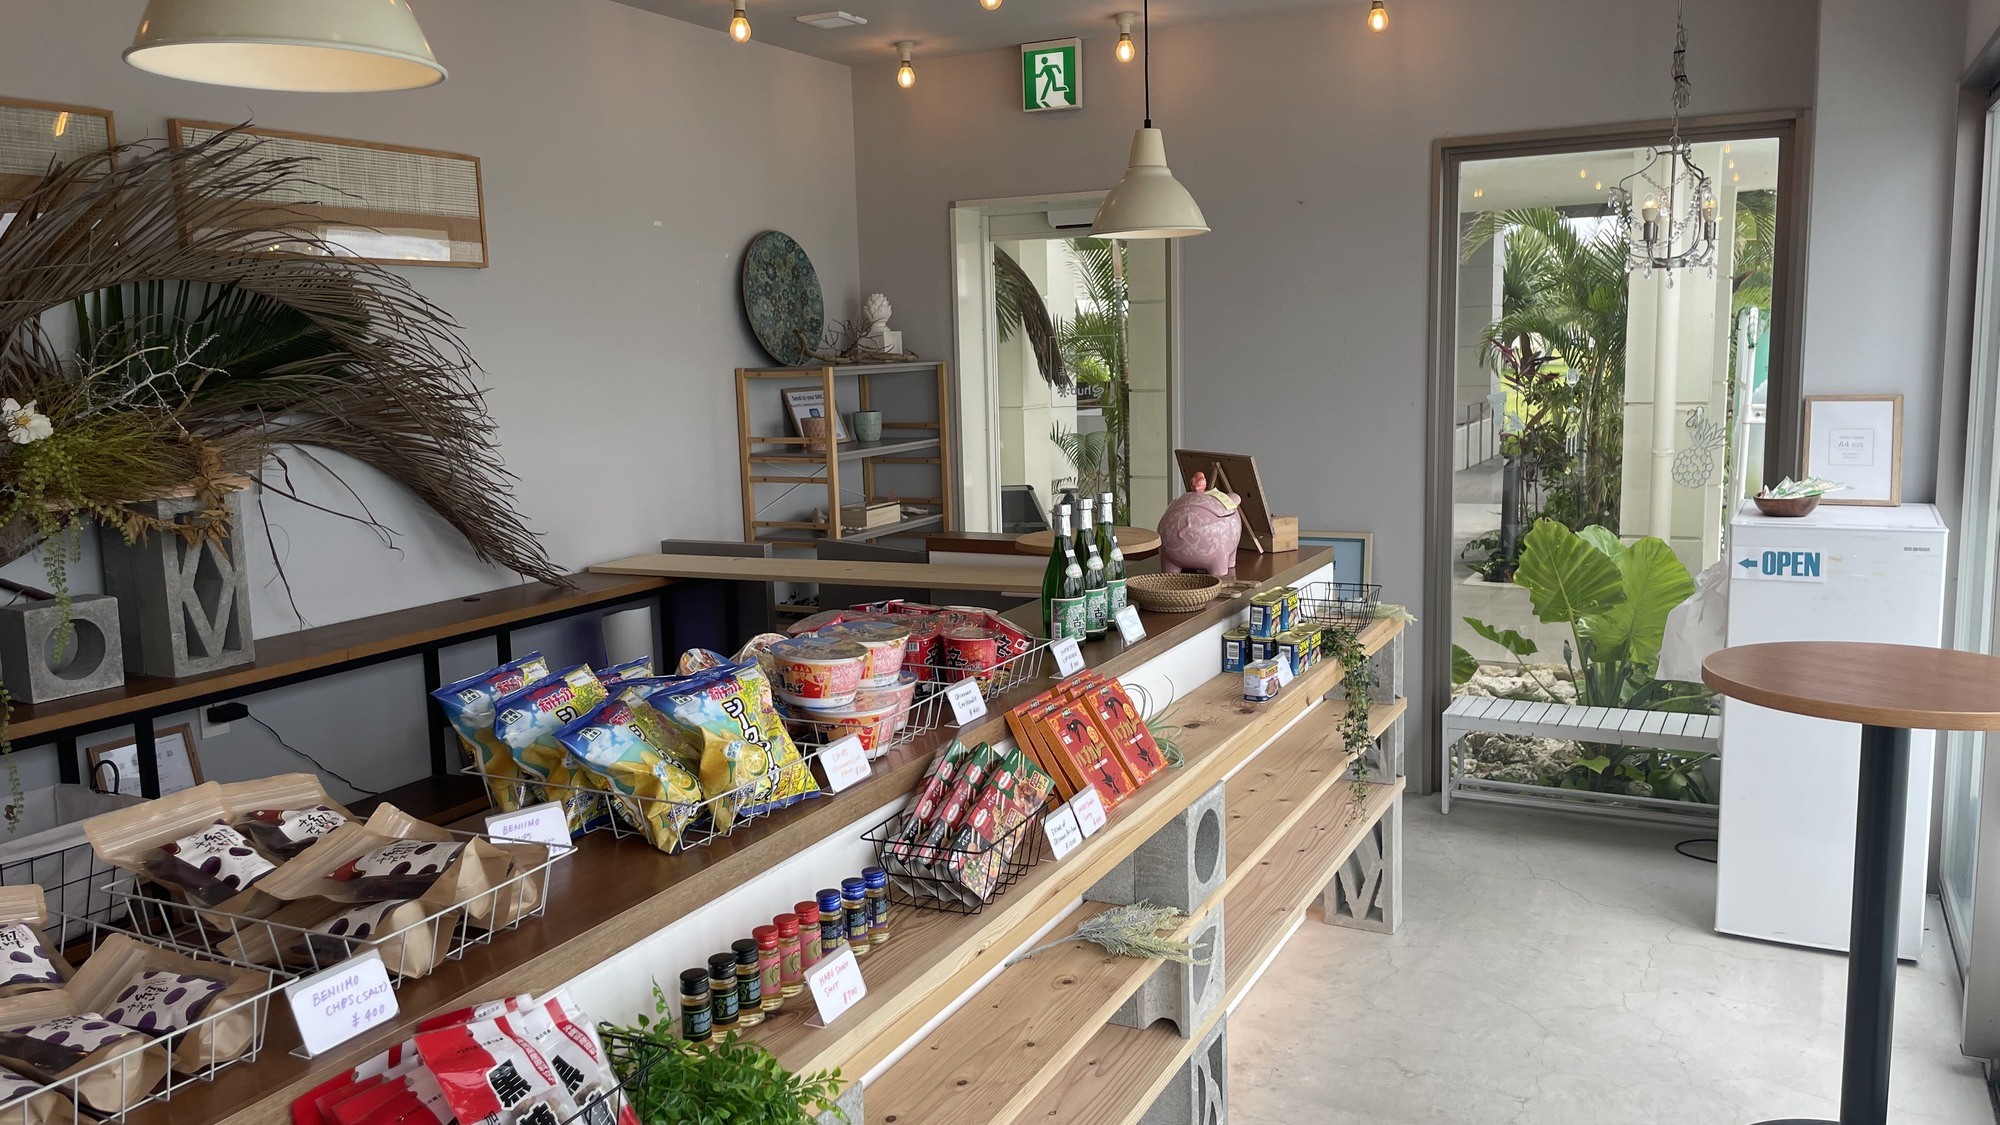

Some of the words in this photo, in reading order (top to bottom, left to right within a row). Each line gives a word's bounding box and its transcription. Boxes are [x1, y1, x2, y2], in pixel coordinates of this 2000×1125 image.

[1762, 551, 1821, 577] OPEN
[502, 818, 540, 836] BENIIMO
[312, 975, 359, 1008] BENIIMO
